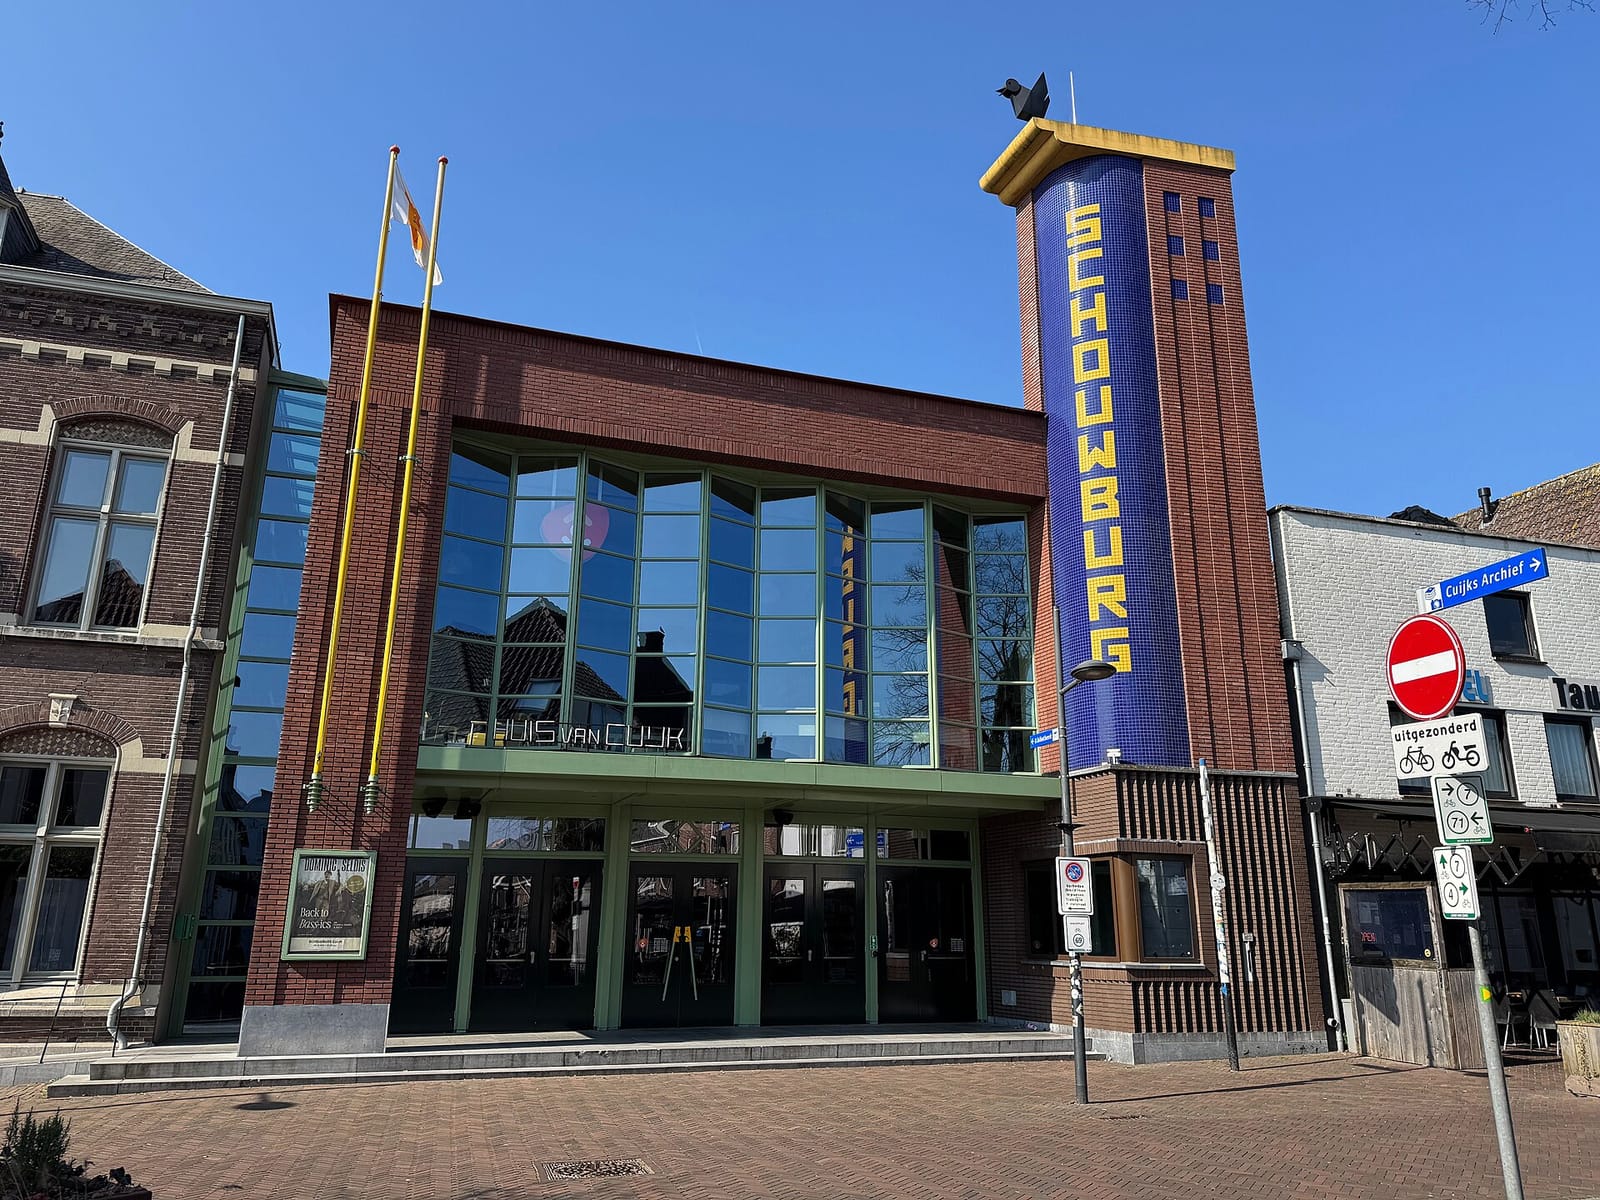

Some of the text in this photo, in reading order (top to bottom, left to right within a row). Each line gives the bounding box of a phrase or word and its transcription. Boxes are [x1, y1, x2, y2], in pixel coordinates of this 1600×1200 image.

[1065, 203, 1132, 672] SCHOUWBURG
[1446, 560, 1525, 598] Cuijks Archief
[561, 726, 600, 745] VAN
[1394, 719, 1477, 743] uitgezonderd
[1464, 788, 1472, 800] 7
[1451, 817, 1464, 828] 71
[1454, 860, 1460, 872] 7
[1448, 888, 1454, 900] 4
[300, 907, 329, 918] Back to
